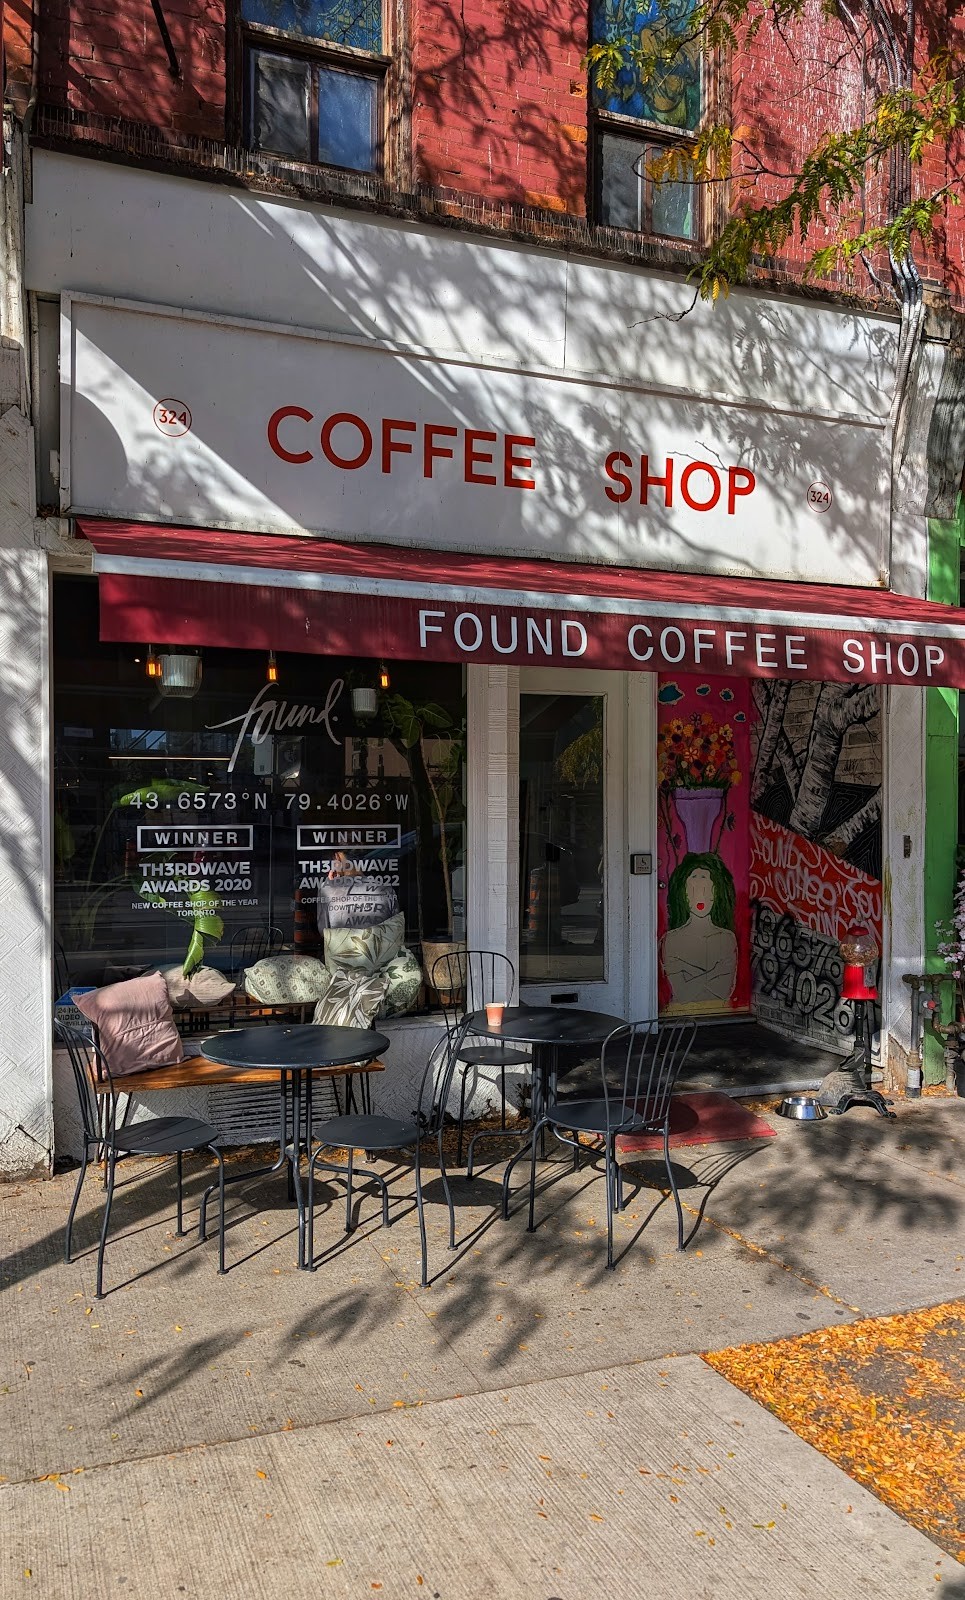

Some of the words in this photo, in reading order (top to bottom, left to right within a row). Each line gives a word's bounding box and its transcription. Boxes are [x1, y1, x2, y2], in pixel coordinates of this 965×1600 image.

[158, 408, 187, 425] 324
[267, 405, 536, 490] COFFEE
[604, 451, 756, 515] SHOP
[810, 490, 829, 504] 324
[418, 609, 589, 658] FOUND
[627, 624, 808, 671] COFFEE
[842, 638, 946, 678] SHOP
[155, 831, 238, 845] WINNER
[313, 830, 387, 844] WINNER
[139, 861, 251, 877] TH3RDWAVE
[298, 859, 399, 873] TH3RDWAVE
[139, 879, 210, 894] AWARDS
[214, 878, 252, 892] 2020
[299, 875, 363, 889] AWARDS
[366, 874, 400, 887] 2022
[131, 902, 150, 910] NEW
[151, 901, 183, 909] COFFEE
[184, 900, 207, 908] SHOP
[208, 899, 220, 907] OF
[221, 899, 236, 907] THE
[238, 898, 258, 906] YEAR
[176, 909, 216, 917] TORONTO
